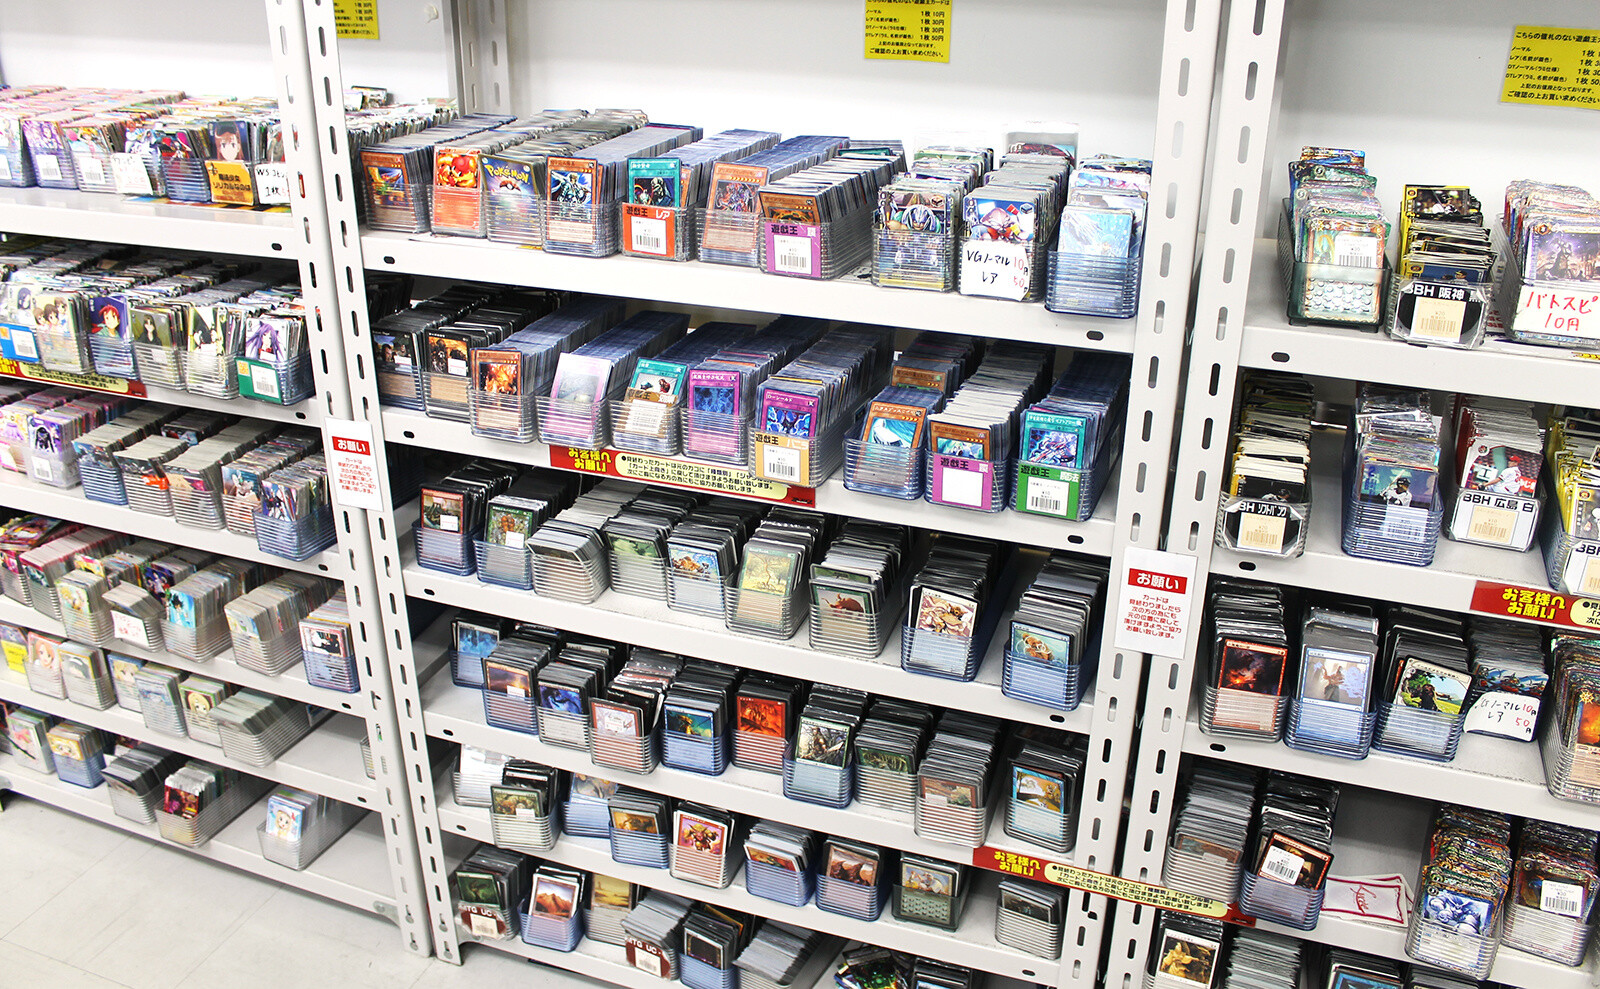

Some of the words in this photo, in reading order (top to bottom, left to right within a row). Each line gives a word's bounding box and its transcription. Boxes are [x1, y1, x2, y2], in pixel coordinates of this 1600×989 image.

[626, 205, 648, 217] 遊戯王
[771, 224, 798, 235] 遊戯王
[1438, 287, 1465, 300] 阪神
[1526, 291, 1599, 315] バトスピ
[1544, 313, 1579, 332] 10円
[337, 439, 366, 452] お願い
[755, 433, 779, 445] 遊戯王
[574, 458, 607, 473] お願い
[940, 457, 969, 470] 遊戯王
[1020, 464, 1050, 478] 遊戯王
[1494, 498, 1518, 511] 広島
[1522, 502, 1534, 513] 白
[1136, 572, 1179, 590] お願い
[1129, 598, 1181, 613] 見終わりましたら
[1142, 594, 1169, 604] カードは
[1502, 588, 1566, 610] お客様へ
[1131, 605, 1177, 619] 次の方の為にも
[1507, 601, 1556, 620] お願い
[1123, 618, 1182, 634] 頂けますようご協力
[1127, 611, 1180, 626] 元の位置に戻して
[1126, 625, 1175, 639] お願い致します。
[993, 851, 1041, 870] お客様へ
[999, 861, 1035, 877] お願い
